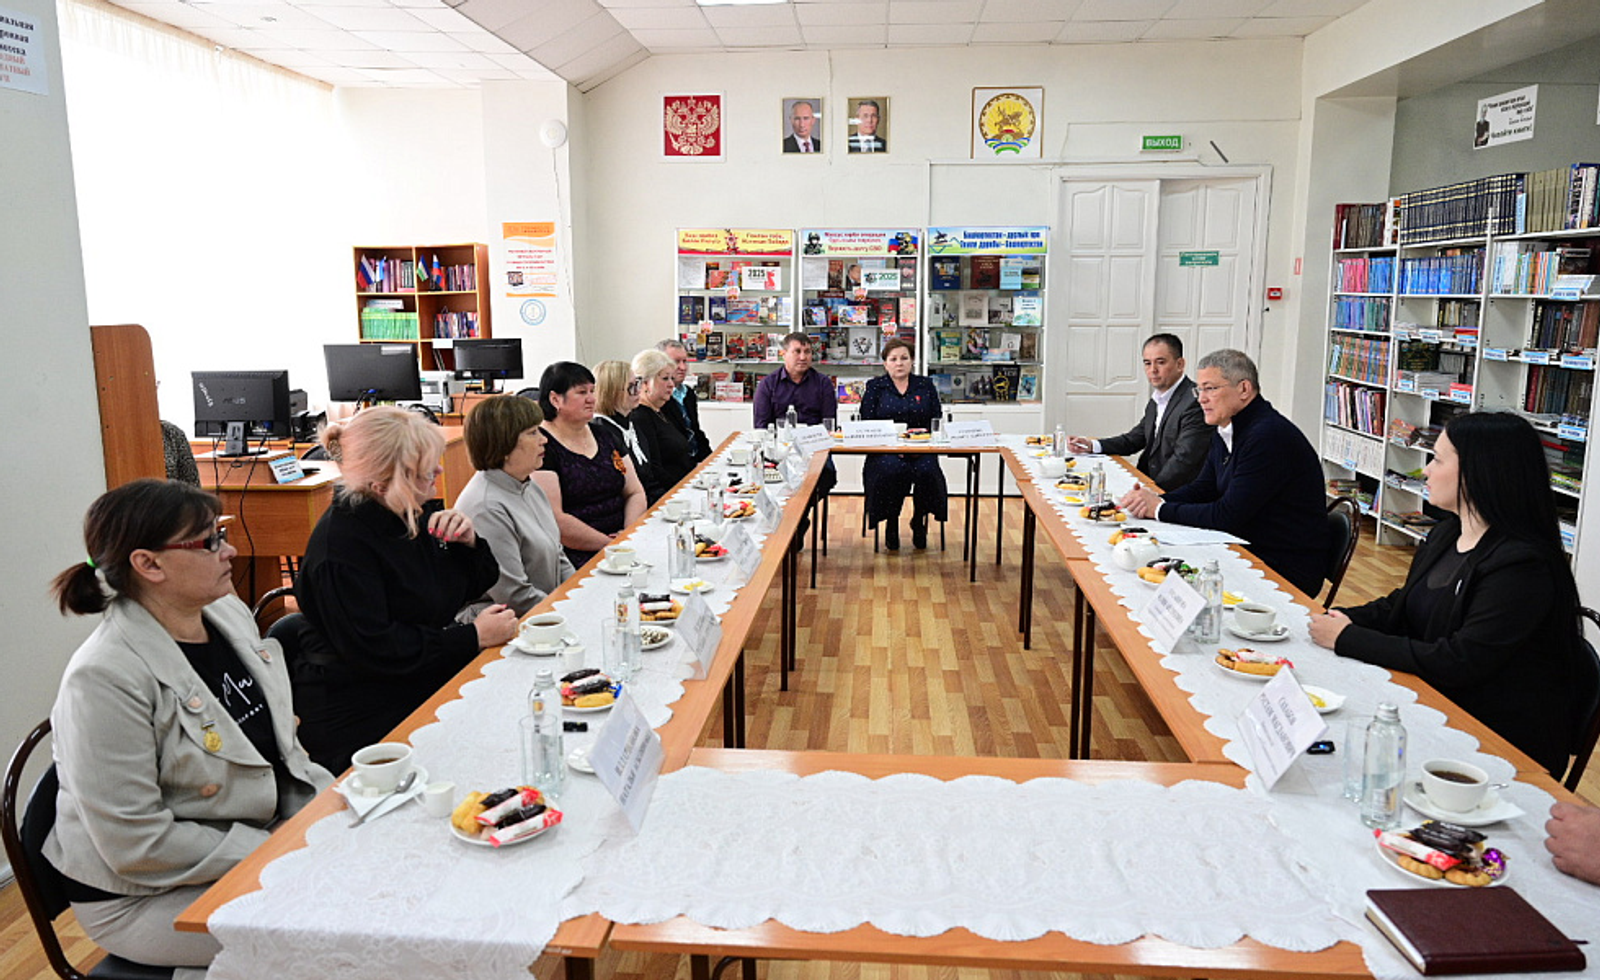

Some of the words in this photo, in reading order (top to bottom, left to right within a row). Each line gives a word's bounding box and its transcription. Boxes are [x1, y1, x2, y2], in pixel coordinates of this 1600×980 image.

[1146, 138, 1178, 147] ВЫХОД
[747, 269, 766, 278] 2025
[879, 272, 898, 281] 2025
